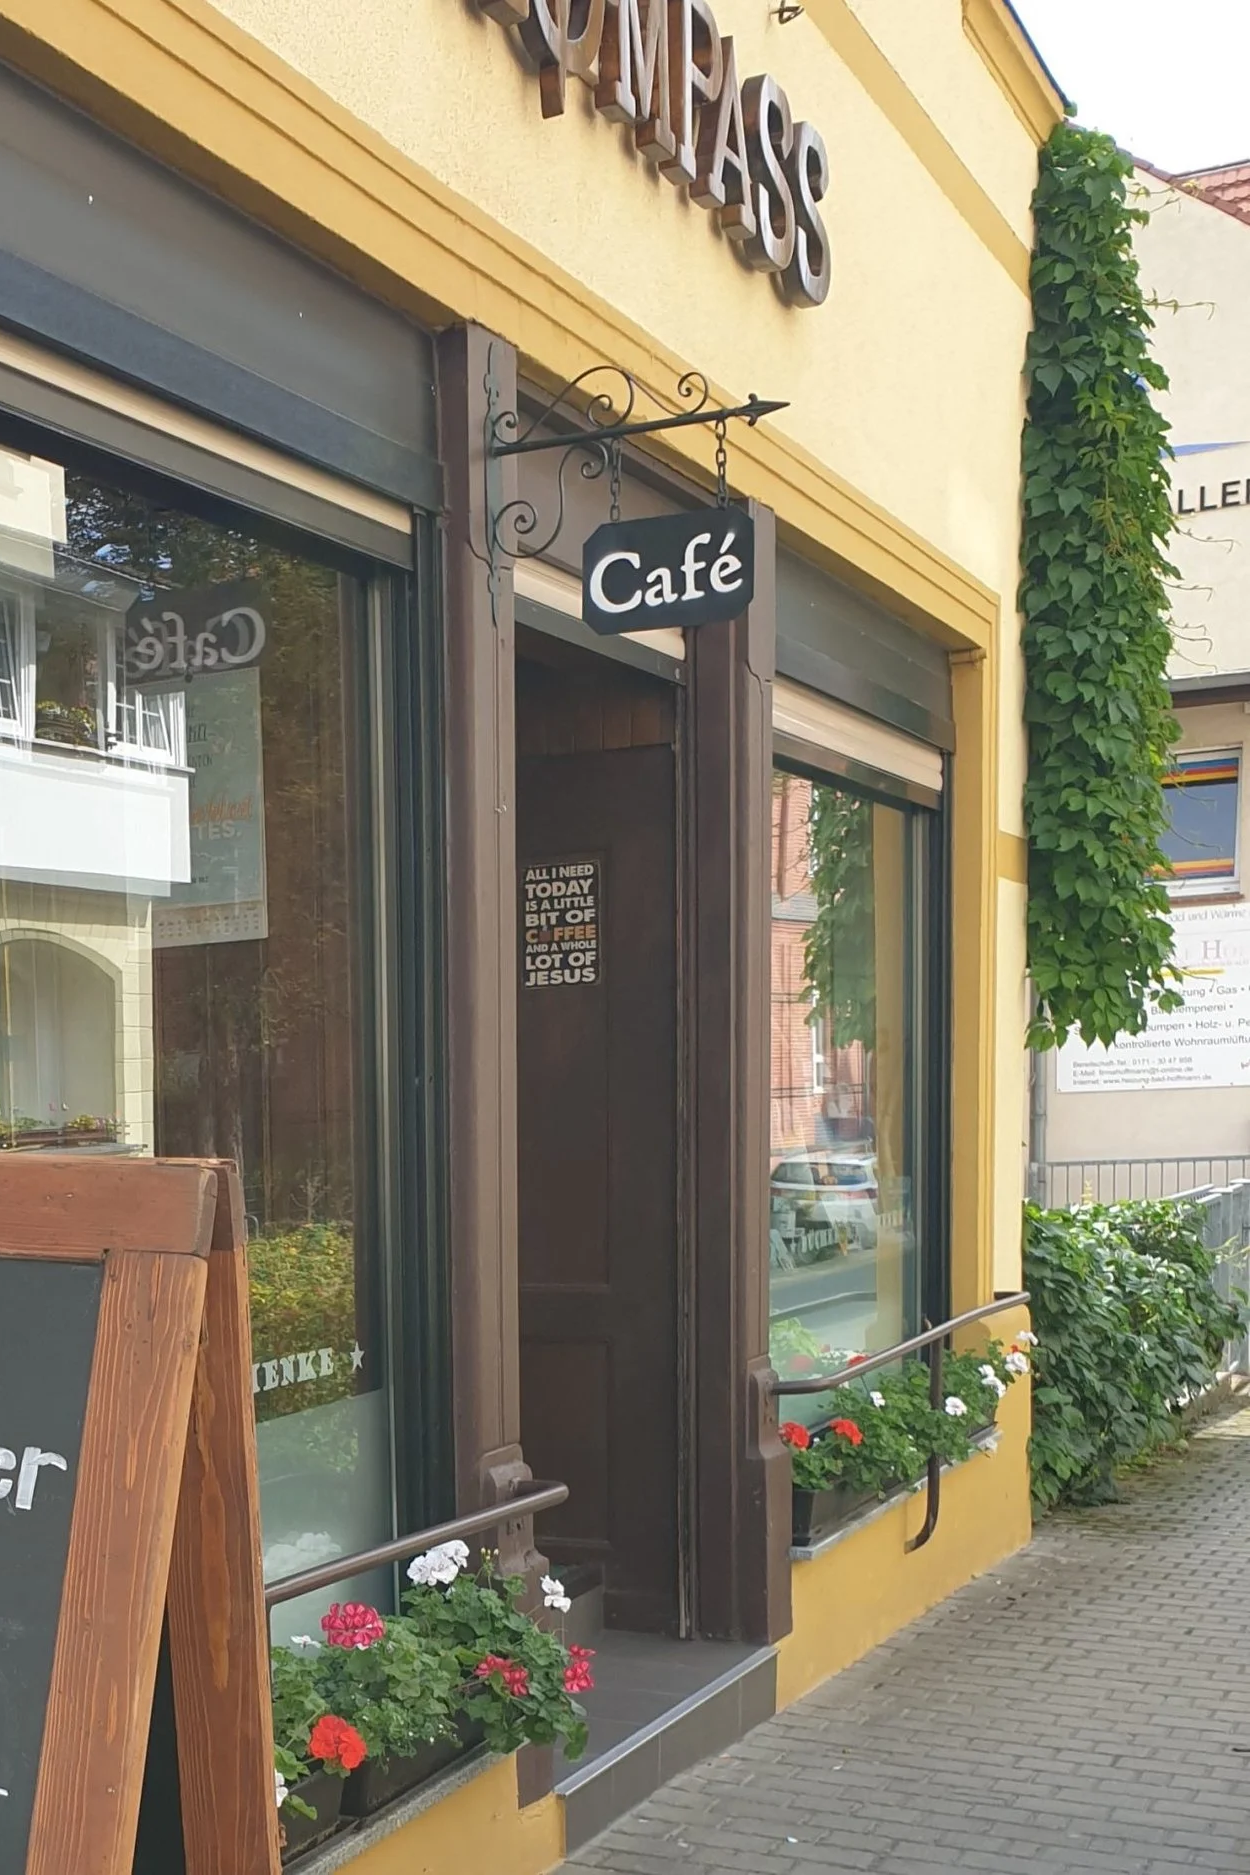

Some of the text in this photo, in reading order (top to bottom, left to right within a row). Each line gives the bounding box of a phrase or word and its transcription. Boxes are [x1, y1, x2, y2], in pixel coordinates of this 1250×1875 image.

[540, 0, 833, 309] MPASS
[589, 532, 743, 613] Café
[525, 864, 595, 881] ALL I NEED
[525, 879, 594, 900] TODAY
[526, 895, 595, 912] IS A LITTLE
[525, 909, 596, 928] BIT OF
[1187, 909, 1208, 921] und
[526, 939, 597, 954] AND A WHOLE
[526, 951, 597, 971] LOT OF
[525, 967, 596, 987] JESUS
[1216, 984, 1238, 995] Gas
[1195, 1018, 1223, 1030] Holz-
[1113, 1035, 1172, 1050] kontrollierte
